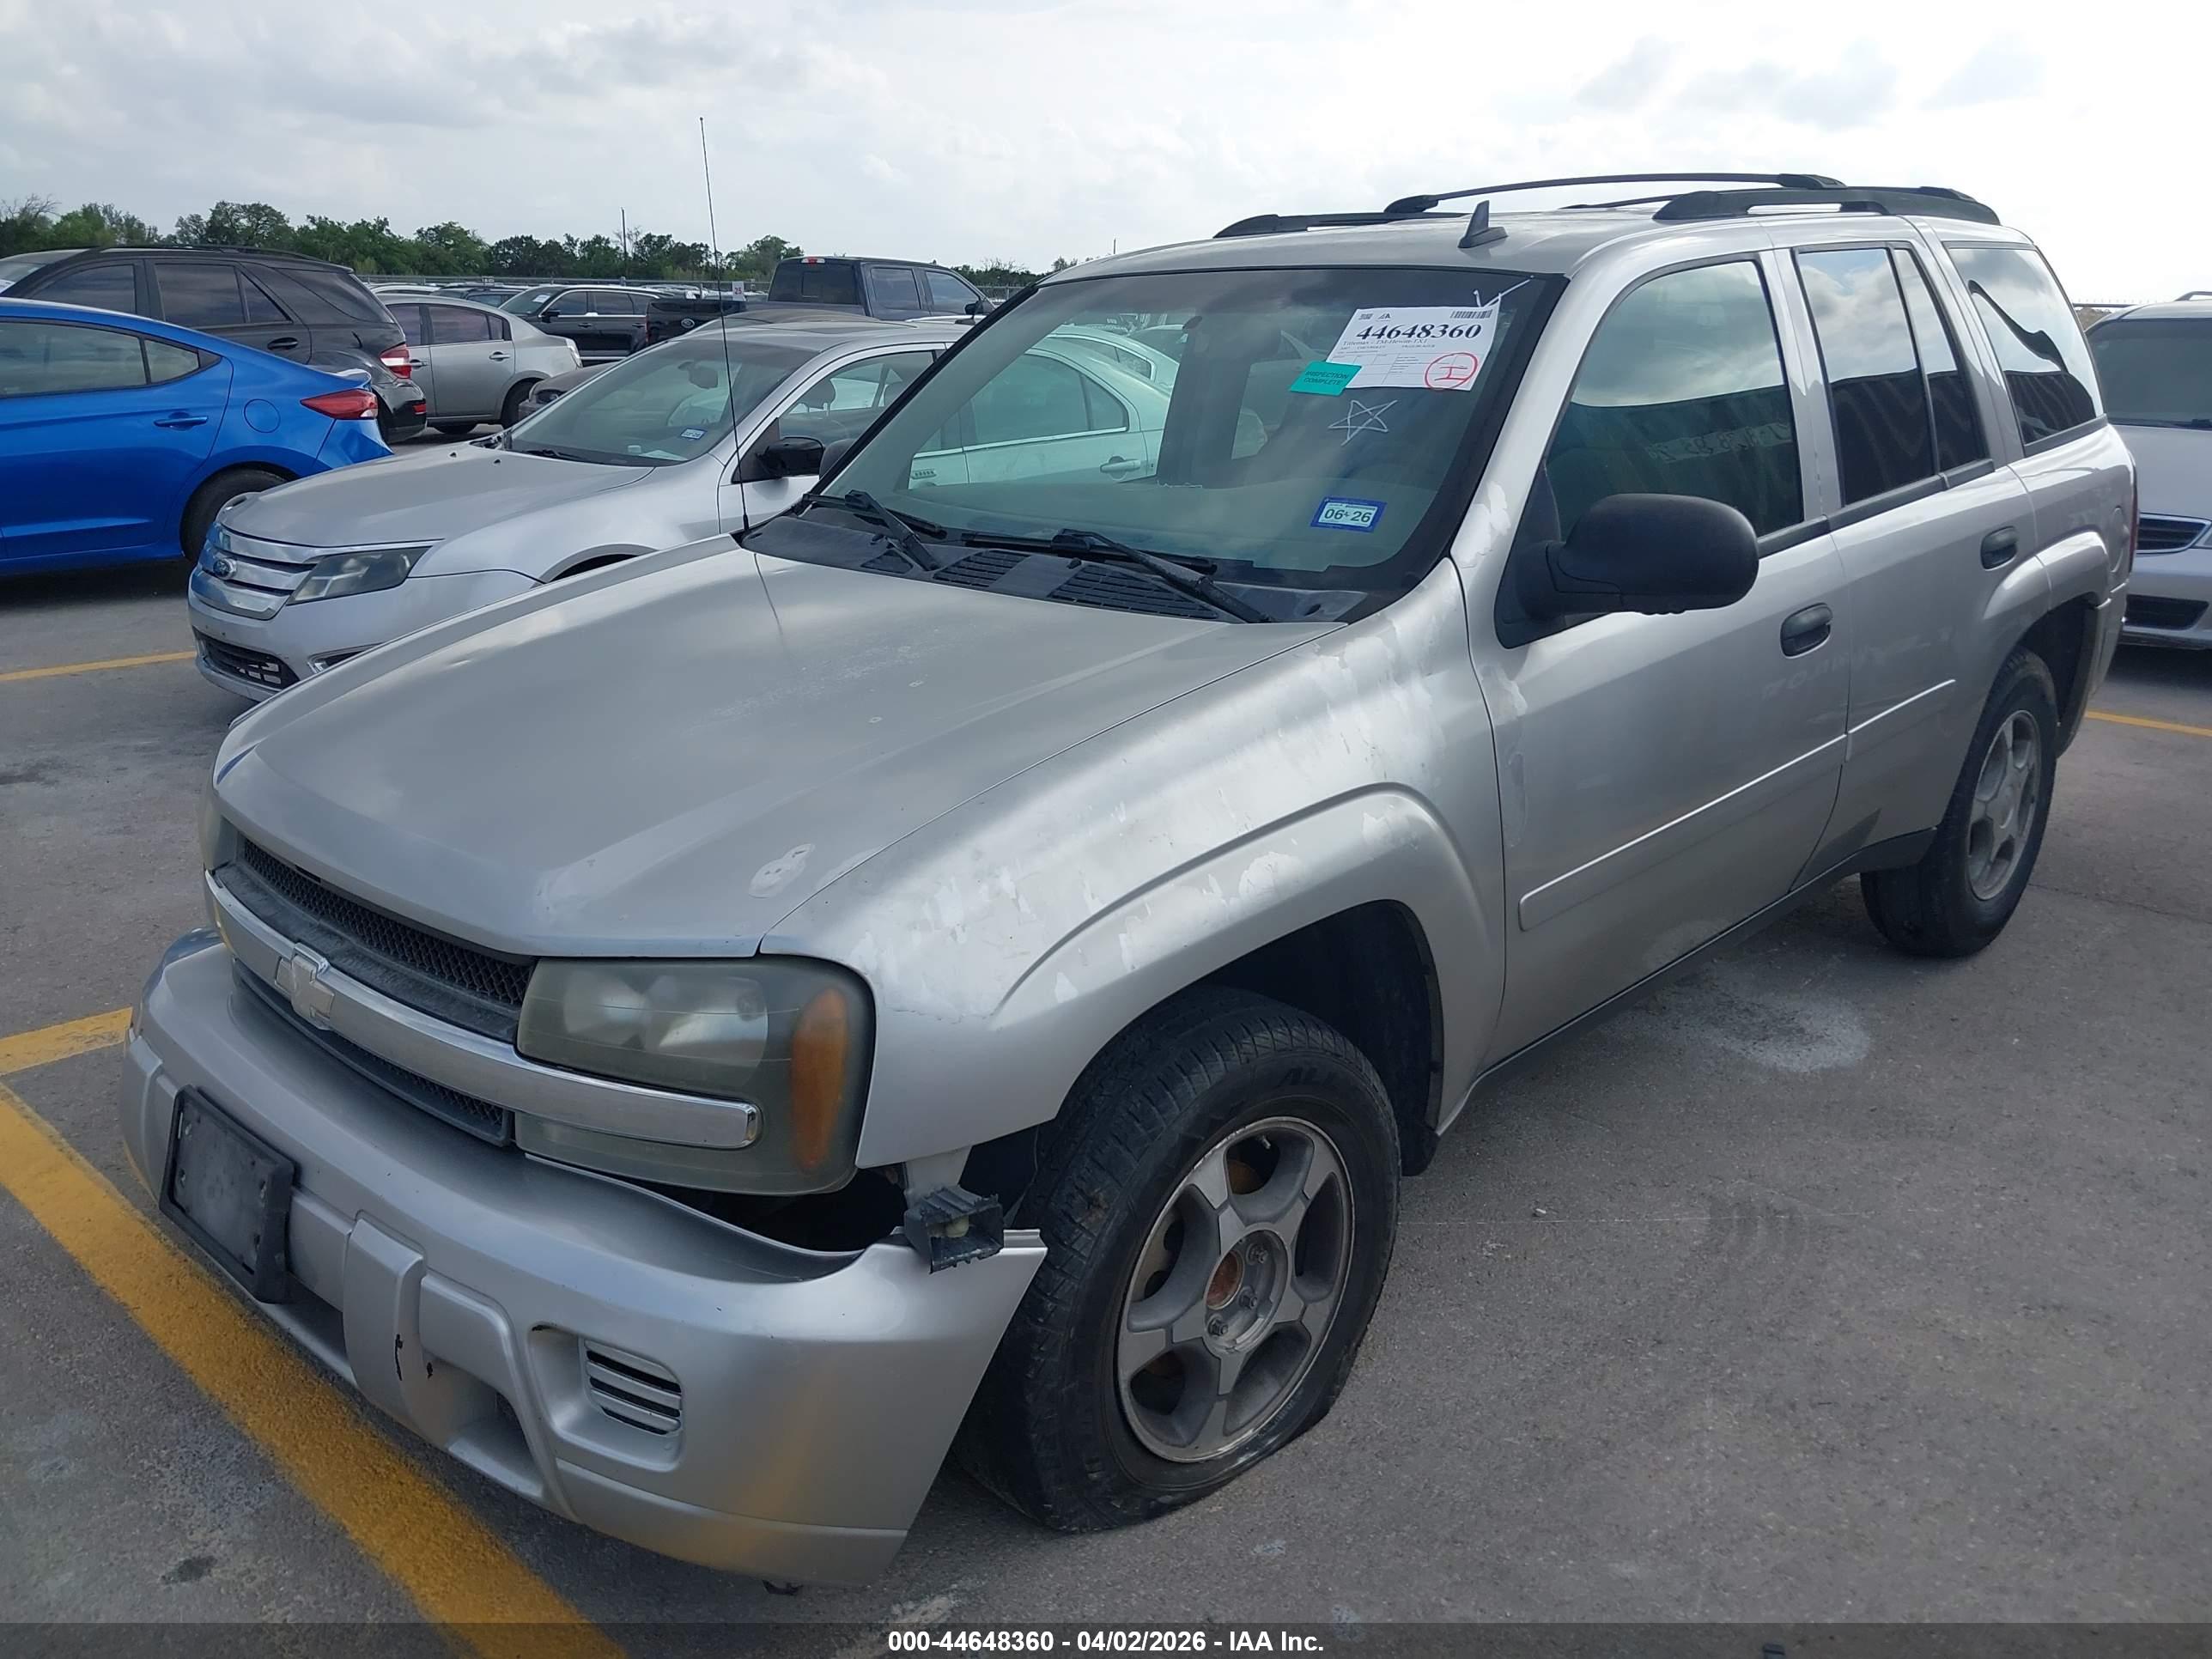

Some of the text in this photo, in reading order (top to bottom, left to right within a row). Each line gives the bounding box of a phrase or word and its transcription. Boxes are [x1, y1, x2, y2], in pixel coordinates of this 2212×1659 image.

[1357, 324, 1482, 340] 44648360
[1304, 370, 1349, 380] INSPECTION
[1303, 377, 1342, 386] COMPLETE
